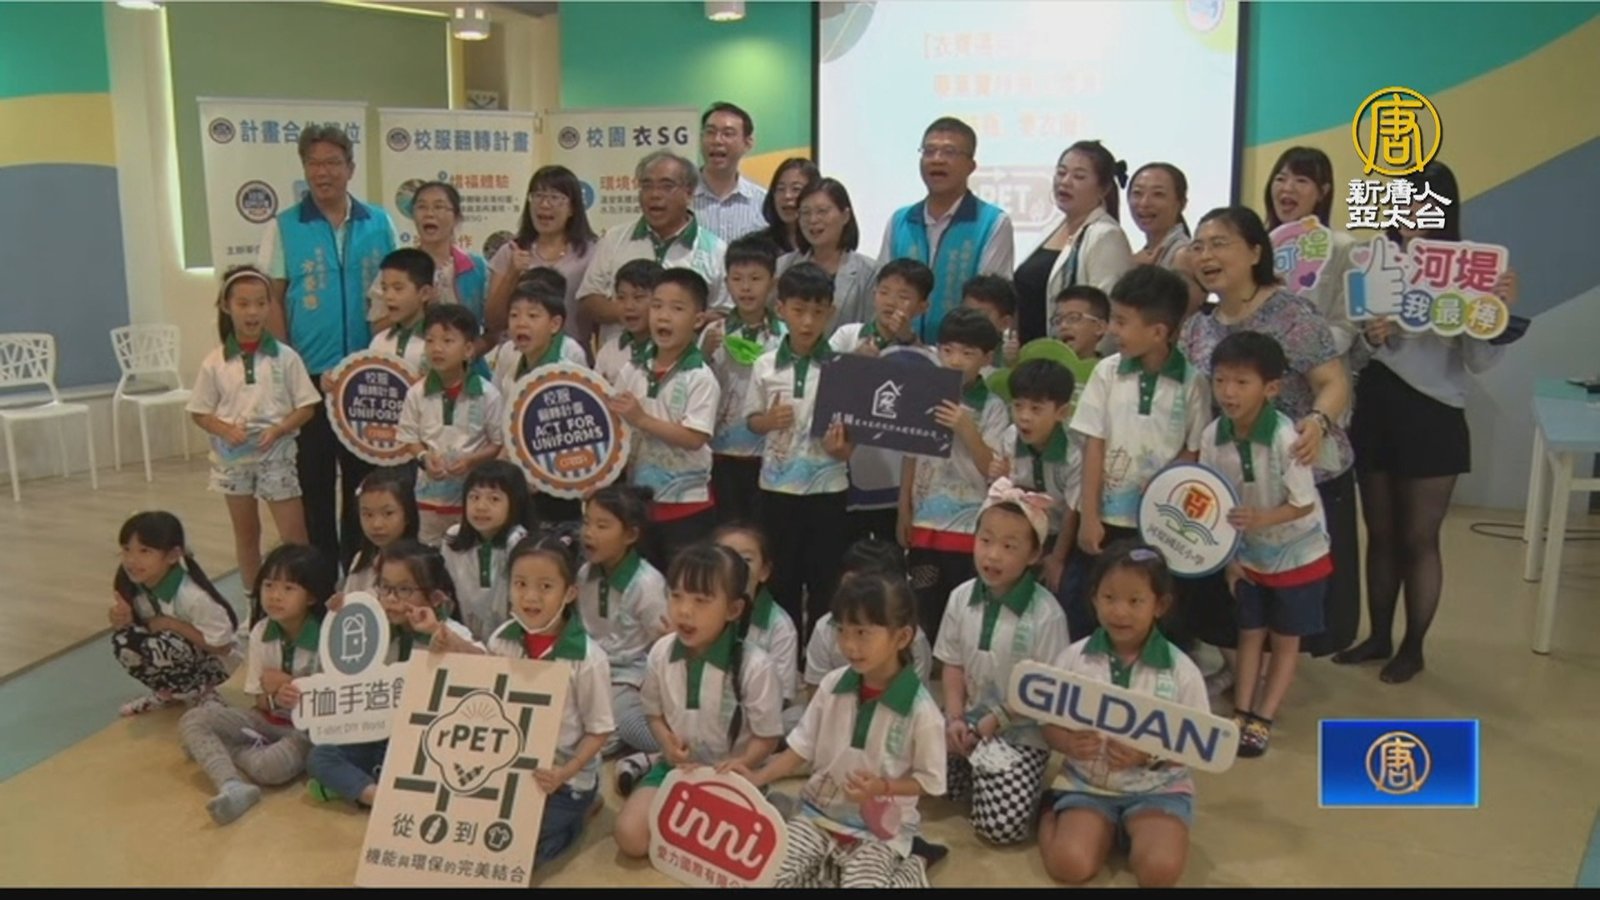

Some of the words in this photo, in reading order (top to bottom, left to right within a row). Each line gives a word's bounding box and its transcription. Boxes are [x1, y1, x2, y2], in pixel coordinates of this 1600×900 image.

[240, 120, 361, 144] 計畫合位
[414, 129, 529, 152] 校服翻轉計畫
[1410, 245, 1498, 293] 河堤
[1402, 292, 1498, 328] 我最棒
[353, 396, 376, 408] ACT
[543, 388, 570, 405] 校服
[349, 408, 400, 420] UNIFORM
[538, 402, 583, 422] 翻轉計畫
[532, 426, 603, 450] UNIFORMS
[535, 422, 561, 438] ACT
[567, 415, 595, 430] FOR
[1018, 673, 1220, 763] GILDAN
[437, 724, 510, 753] rPET
[392, 812, 415, 838] 從
[453, 821, 478, 845] 到
[668, 789, 764, 868] inni
[366, 848, 526, 884] 機能與環保的完美結合
